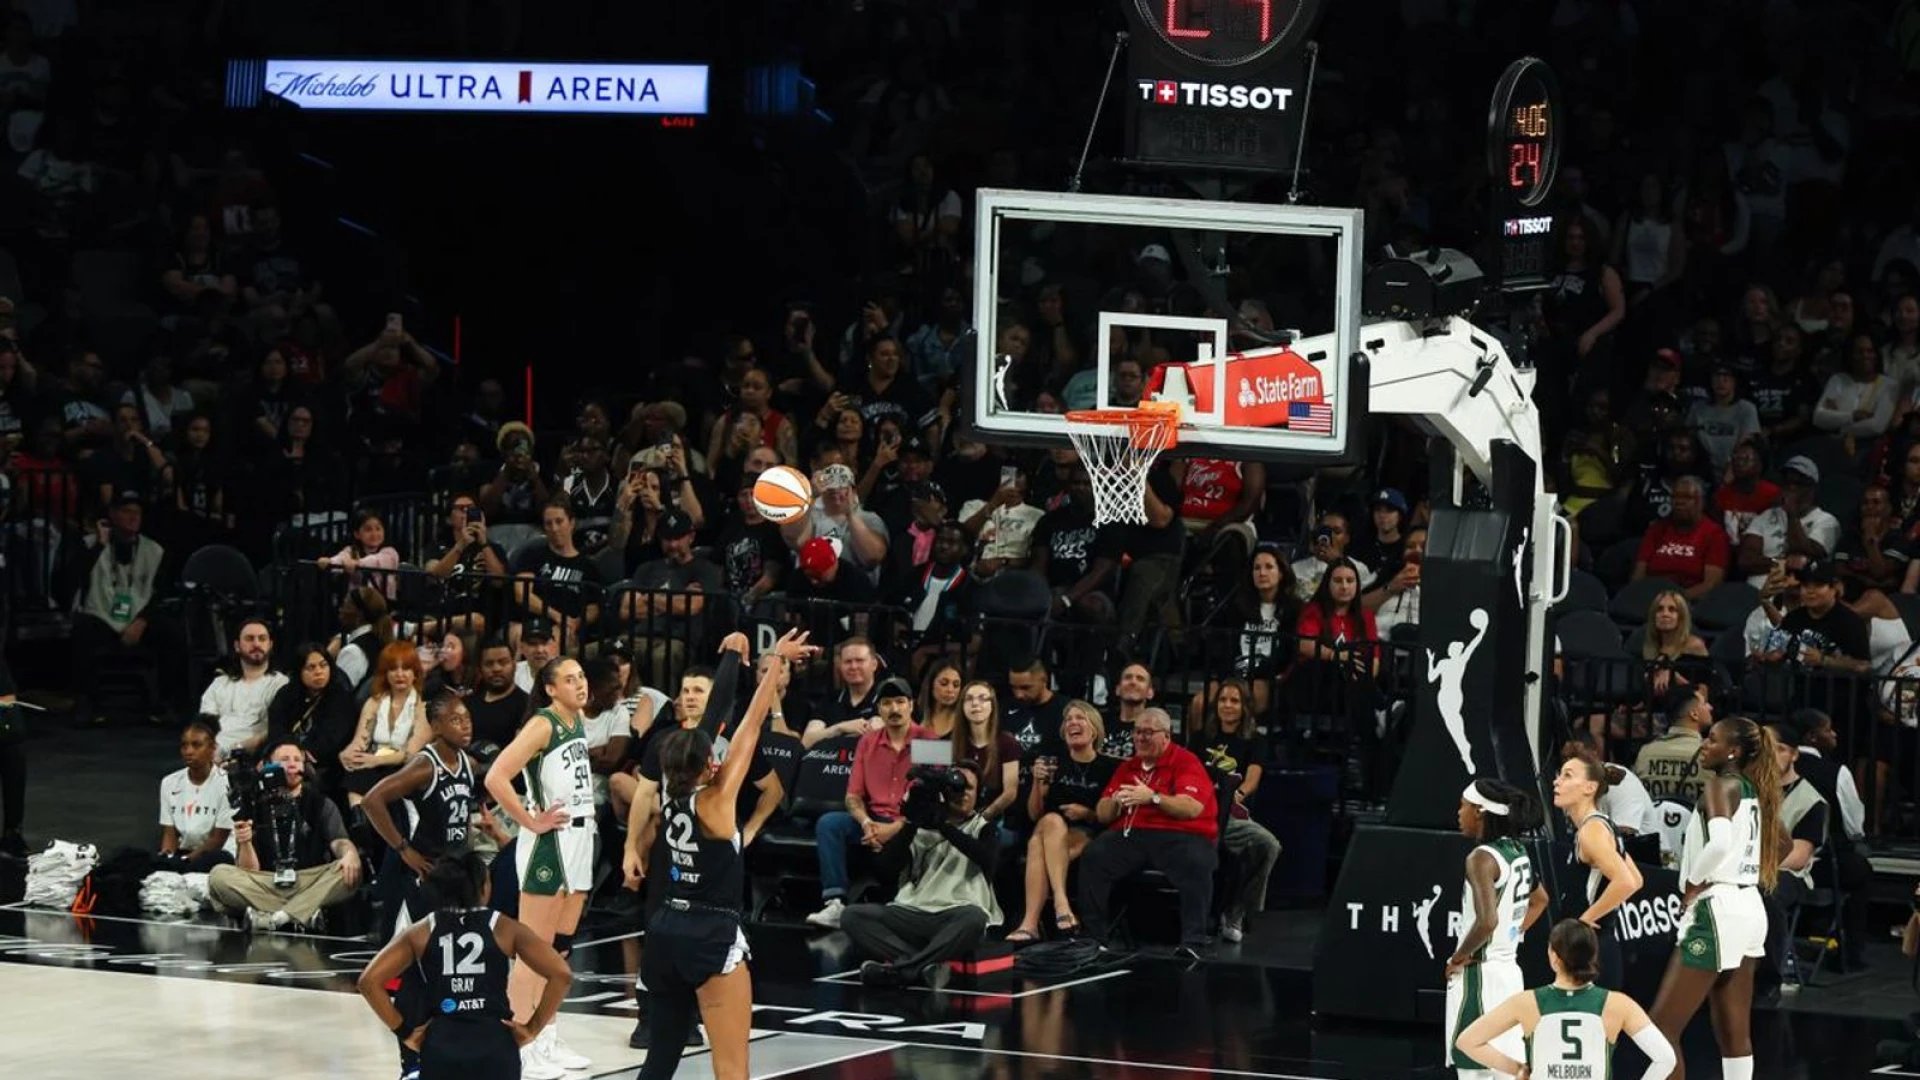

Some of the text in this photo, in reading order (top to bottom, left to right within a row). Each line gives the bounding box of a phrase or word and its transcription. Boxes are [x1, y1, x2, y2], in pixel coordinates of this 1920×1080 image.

[276, 71, 660, 102] Michelob ULTRA ARENA
[1181, 83, 1293, 110] TISSOT
[1511, 143, 1540, 186] 24
[822, 764, 852, 775] AREN
[438, 931, 486, 976] 12
[450, 976, 475, 993] GRAY
[457, 998, 486, 1012] AT&T
[1561, 1019, 1582, 1060] 5
